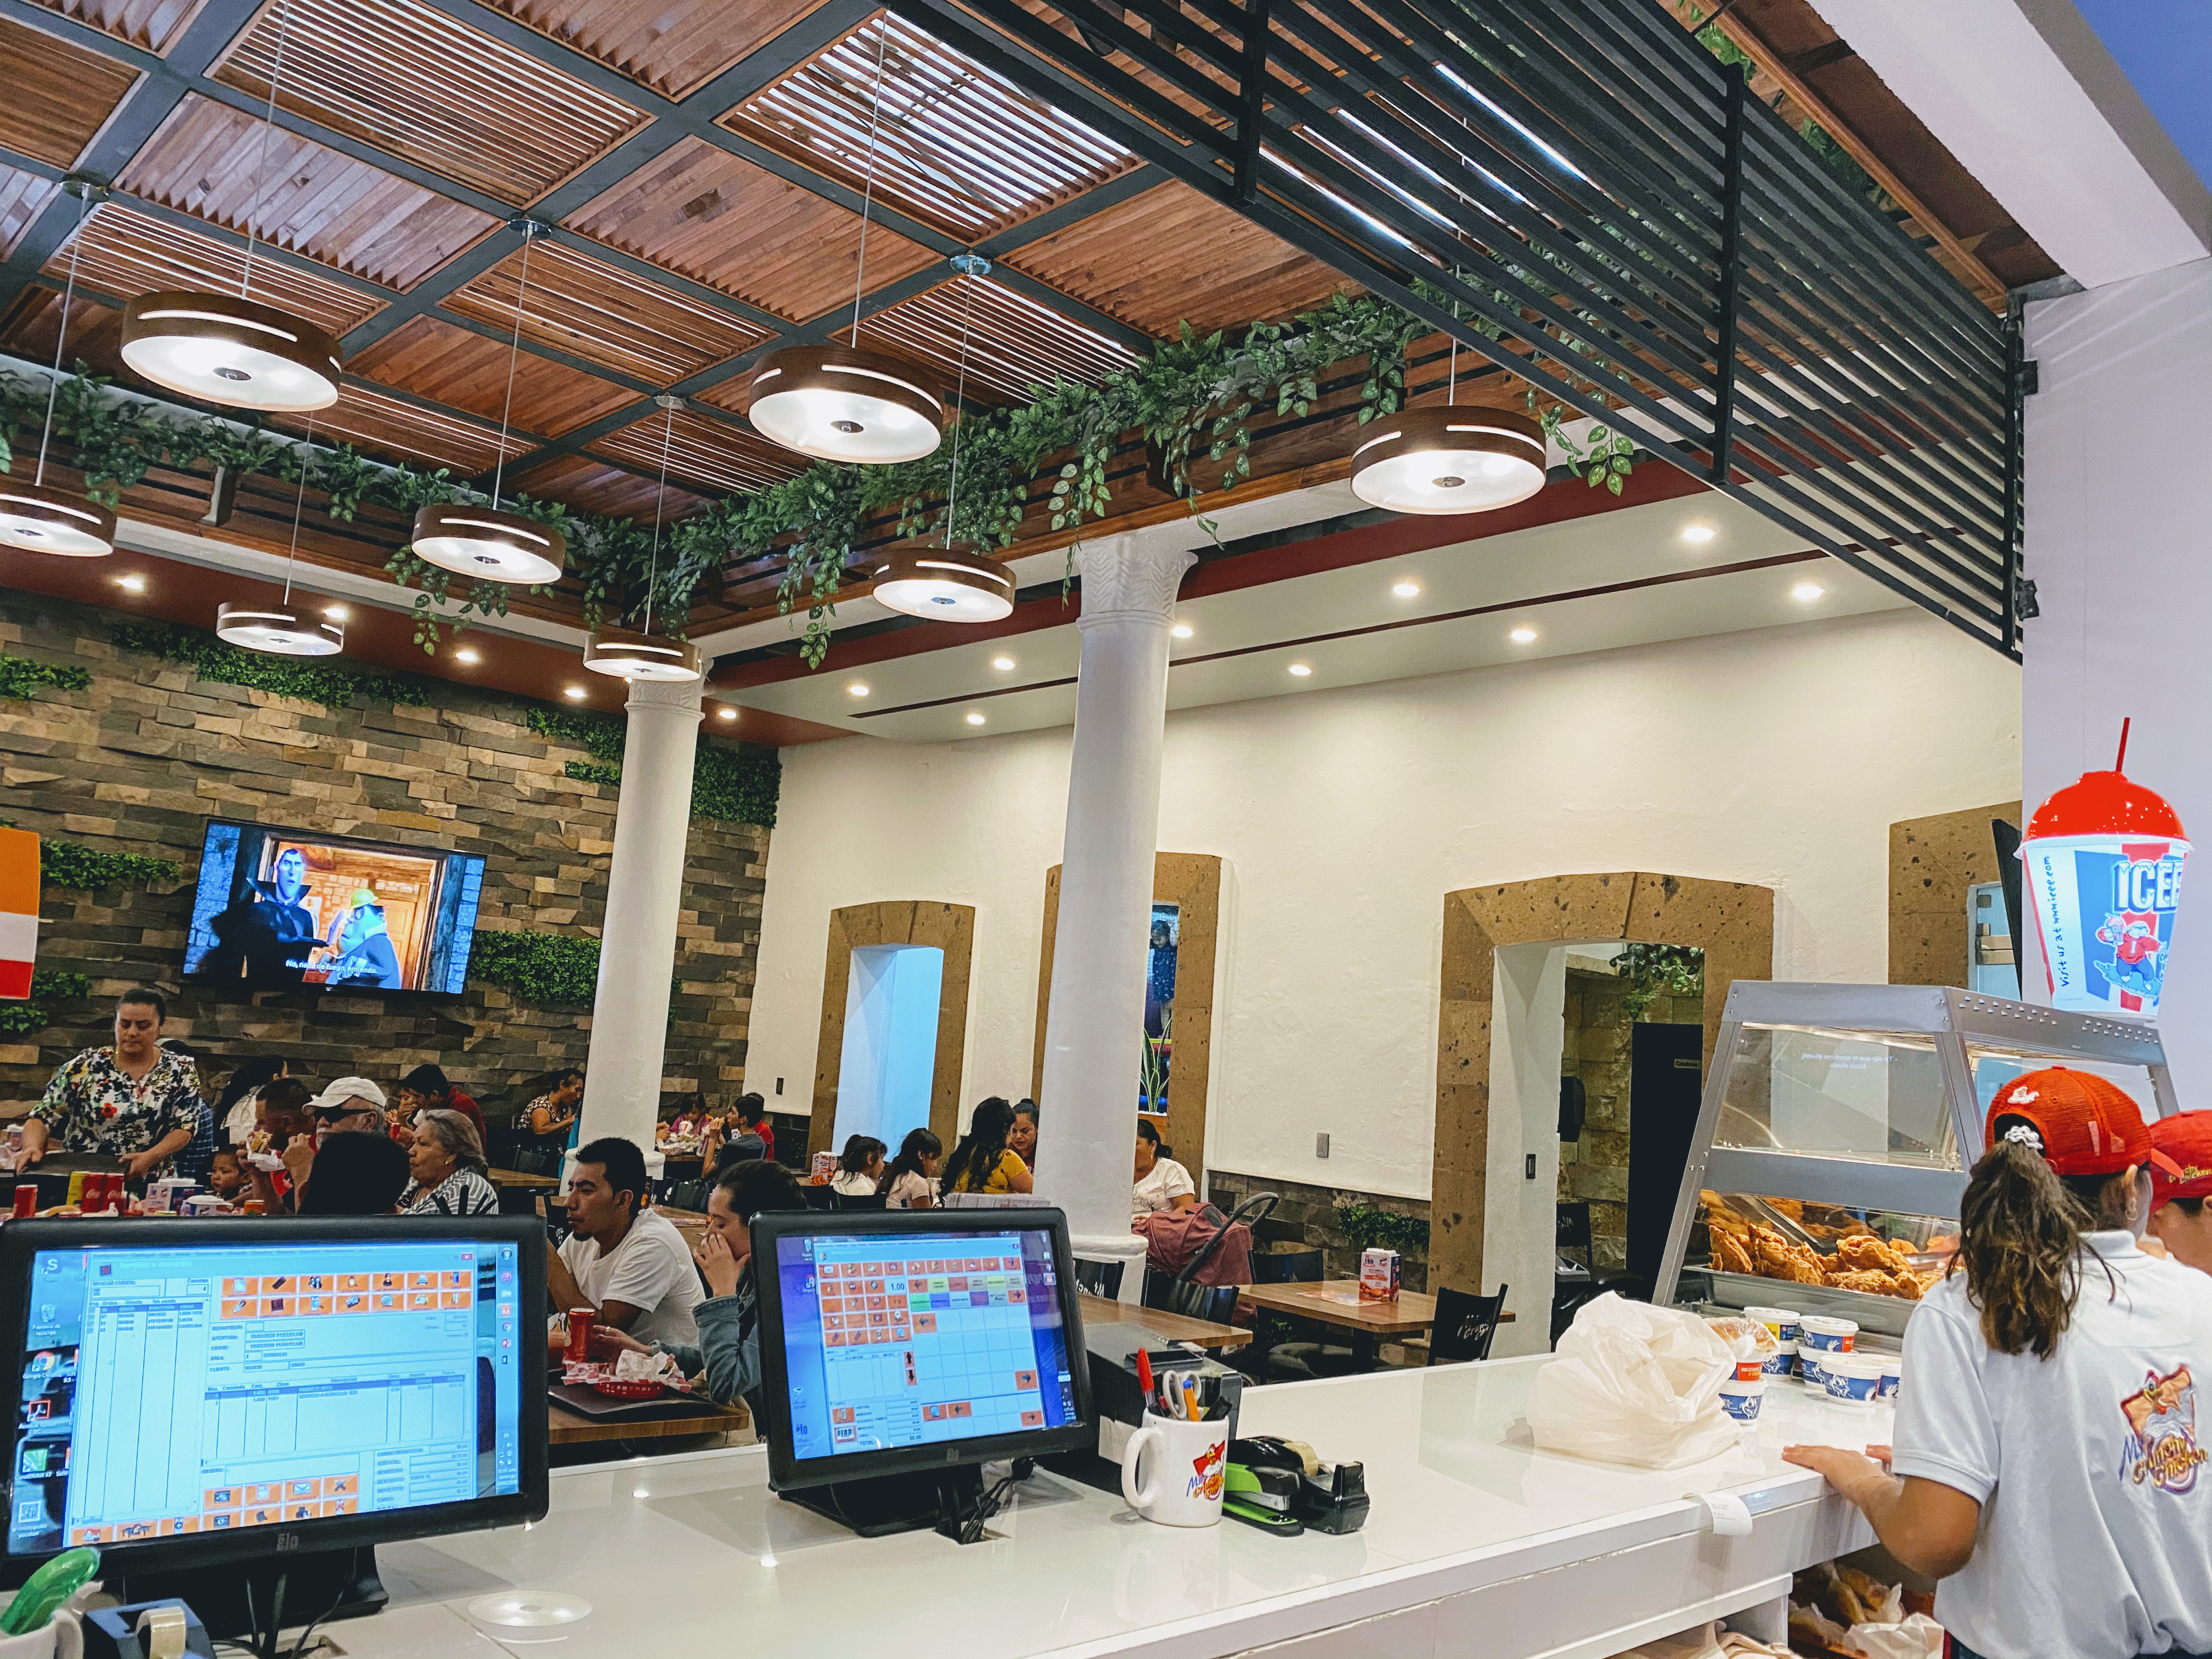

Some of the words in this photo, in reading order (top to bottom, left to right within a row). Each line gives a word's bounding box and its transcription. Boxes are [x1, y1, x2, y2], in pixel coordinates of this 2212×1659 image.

[2114, 861, 2184, 912] ICEE
[2053, 928, 2063, 941] at
[2057, 945, 2064, 957] us
[285, 960, 298, 969] No,
[326, 963, 346, 972] fuego,
[348, 966, 377, 974] entiendo.
[2058, 961, 2070, 987] Visit
[890, 1283, 905, 1291] 1.00
